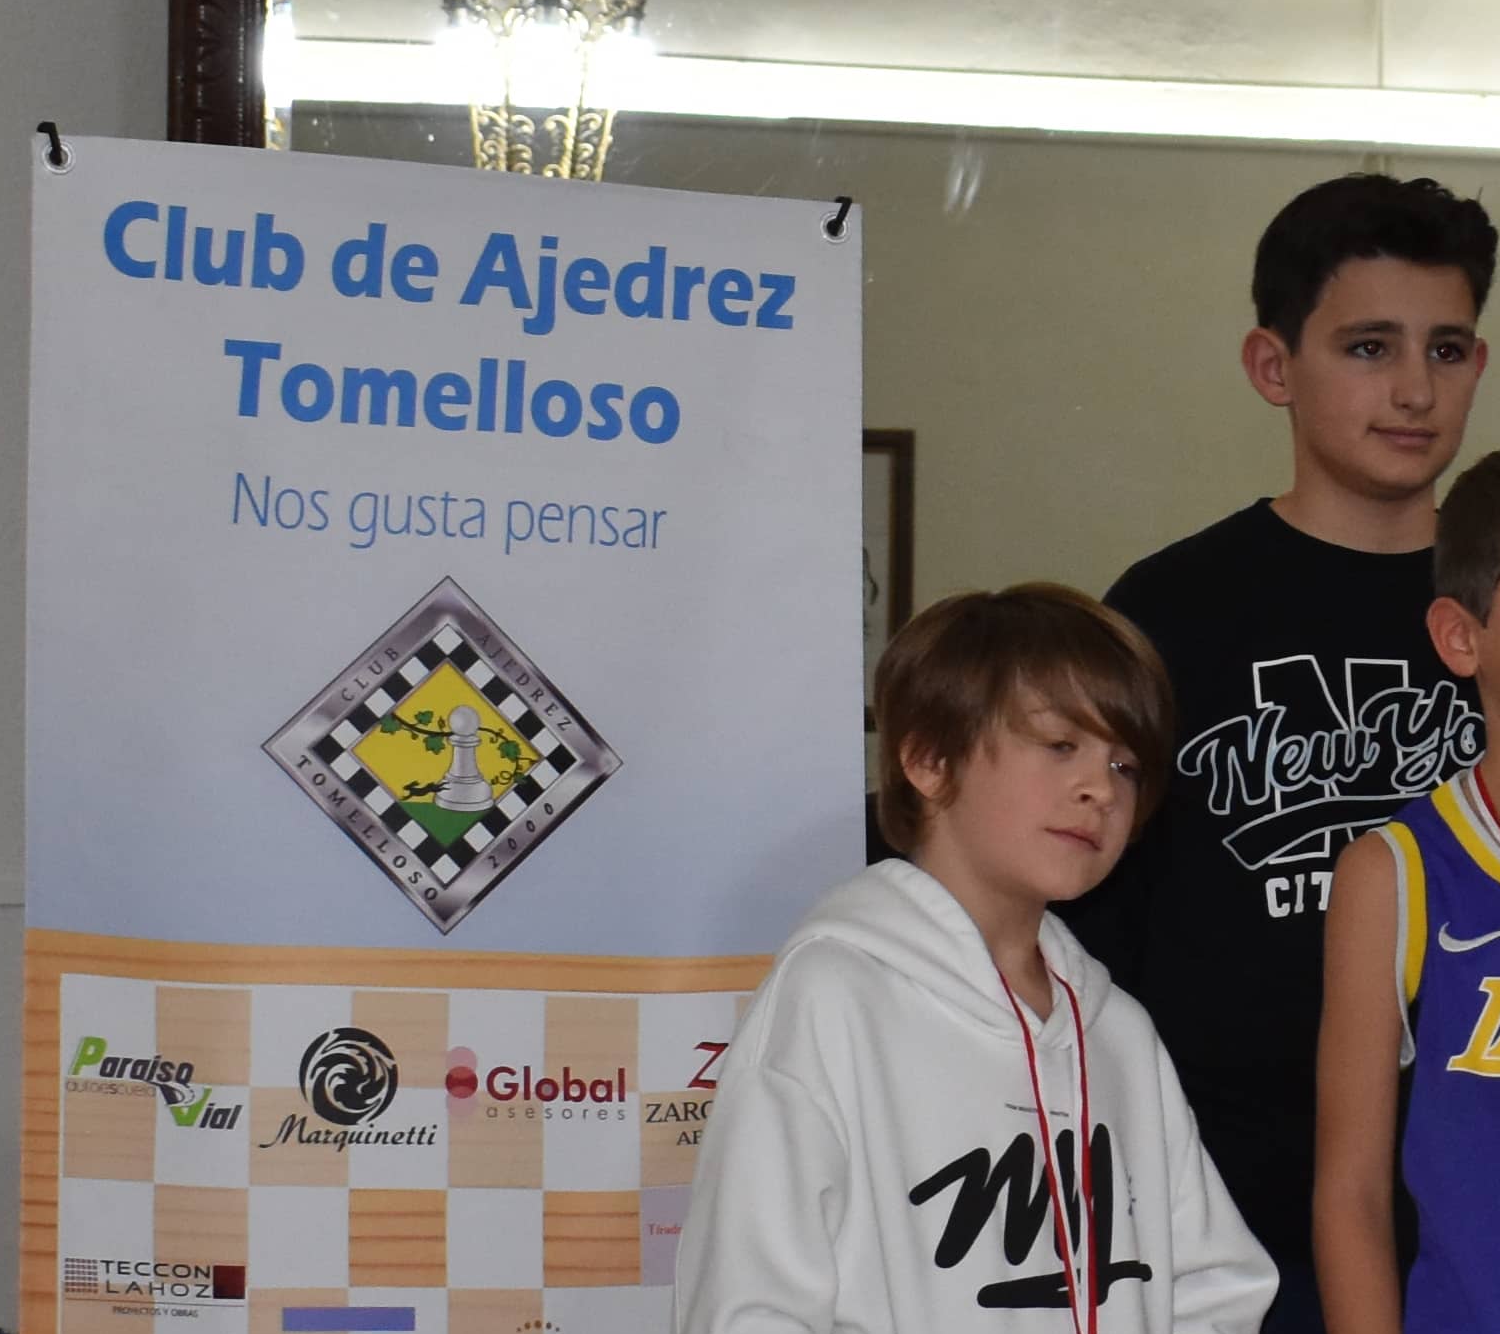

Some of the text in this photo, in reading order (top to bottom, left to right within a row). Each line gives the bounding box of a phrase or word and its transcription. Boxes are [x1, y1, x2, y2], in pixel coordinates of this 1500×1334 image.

[103, 201, 797, 335] Club de Ajedrez
[224, 339, 681, 444] Tomelloso
[232, 473, 666, 554] Nos gusta pensar
[341, 646, 400, 703] CLUB
[476, 634, 573, 732] AJEDREZ
[1177, 705, 1381, 816] New
[296, 755, 439, 903] TOMELLOSO
[488, 803, 555, 869] 2000
[1265, 871, 1334, 918] CIT
[486, 1106, 626, 1120] asesores
[487, 1066, 626, 1103] Global
[258, 1113, 438, 1152] Marquinetti
[100, 1259, 211, 1279] TECCON
[105, 1280, 212, 1298] LAHOZ
